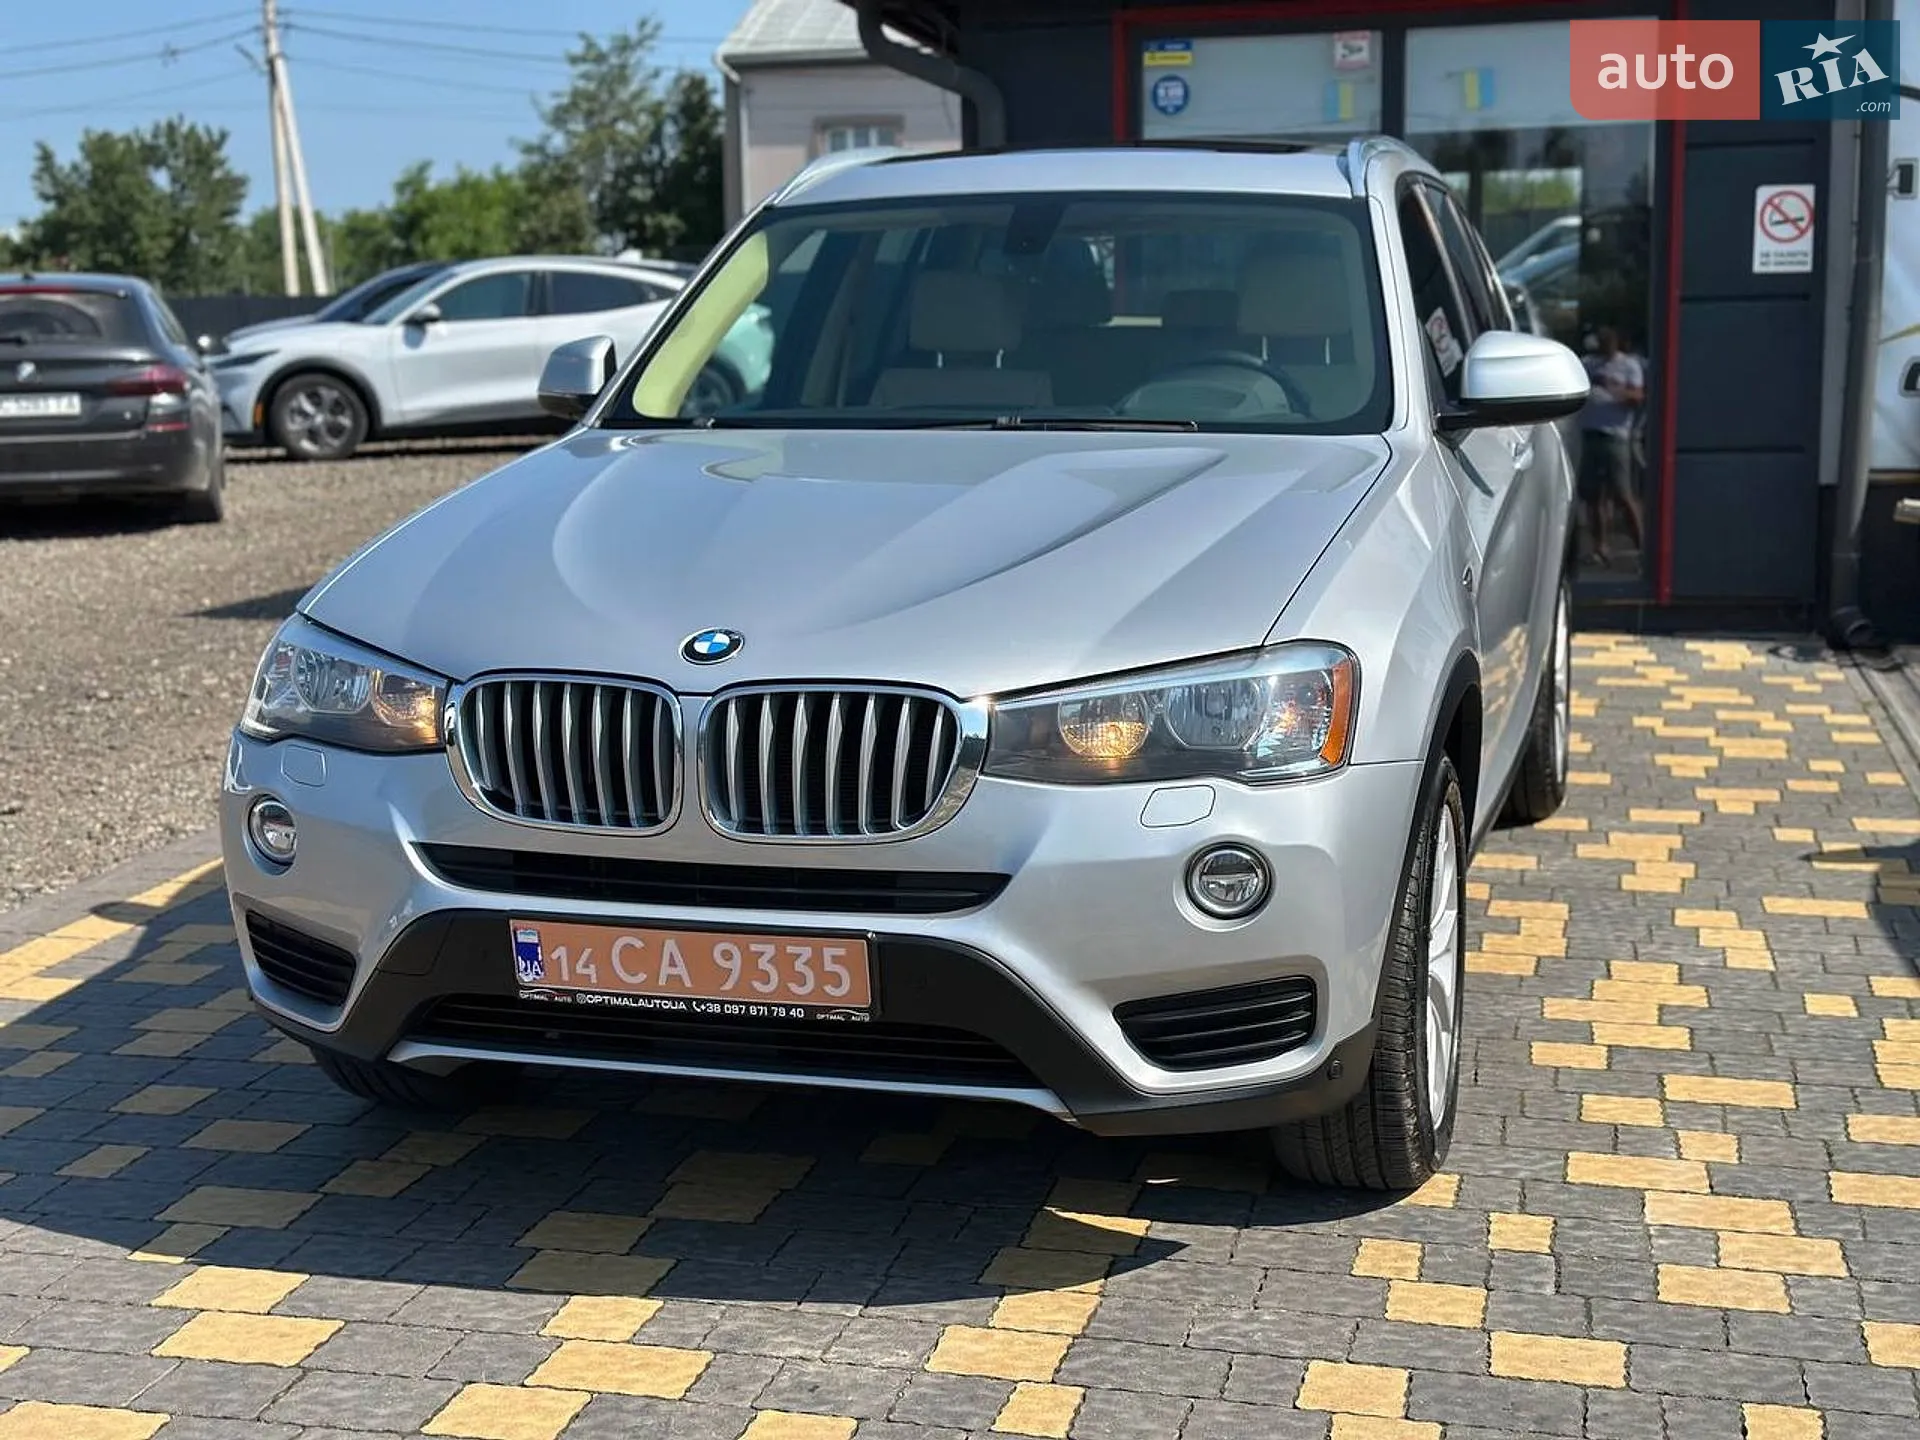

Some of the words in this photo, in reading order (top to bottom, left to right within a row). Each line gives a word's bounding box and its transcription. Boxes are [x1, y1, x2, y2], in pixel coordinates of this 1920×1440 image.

[551, 946, 597, 984] 14
[611, 935, 692, 988] CA
[712, 941, 851, 997] 9335
[700, 1003, 721, 1014] +38
[724, 1003, 746, 1015] 097
[789, 1007, 805, 1018] 40
